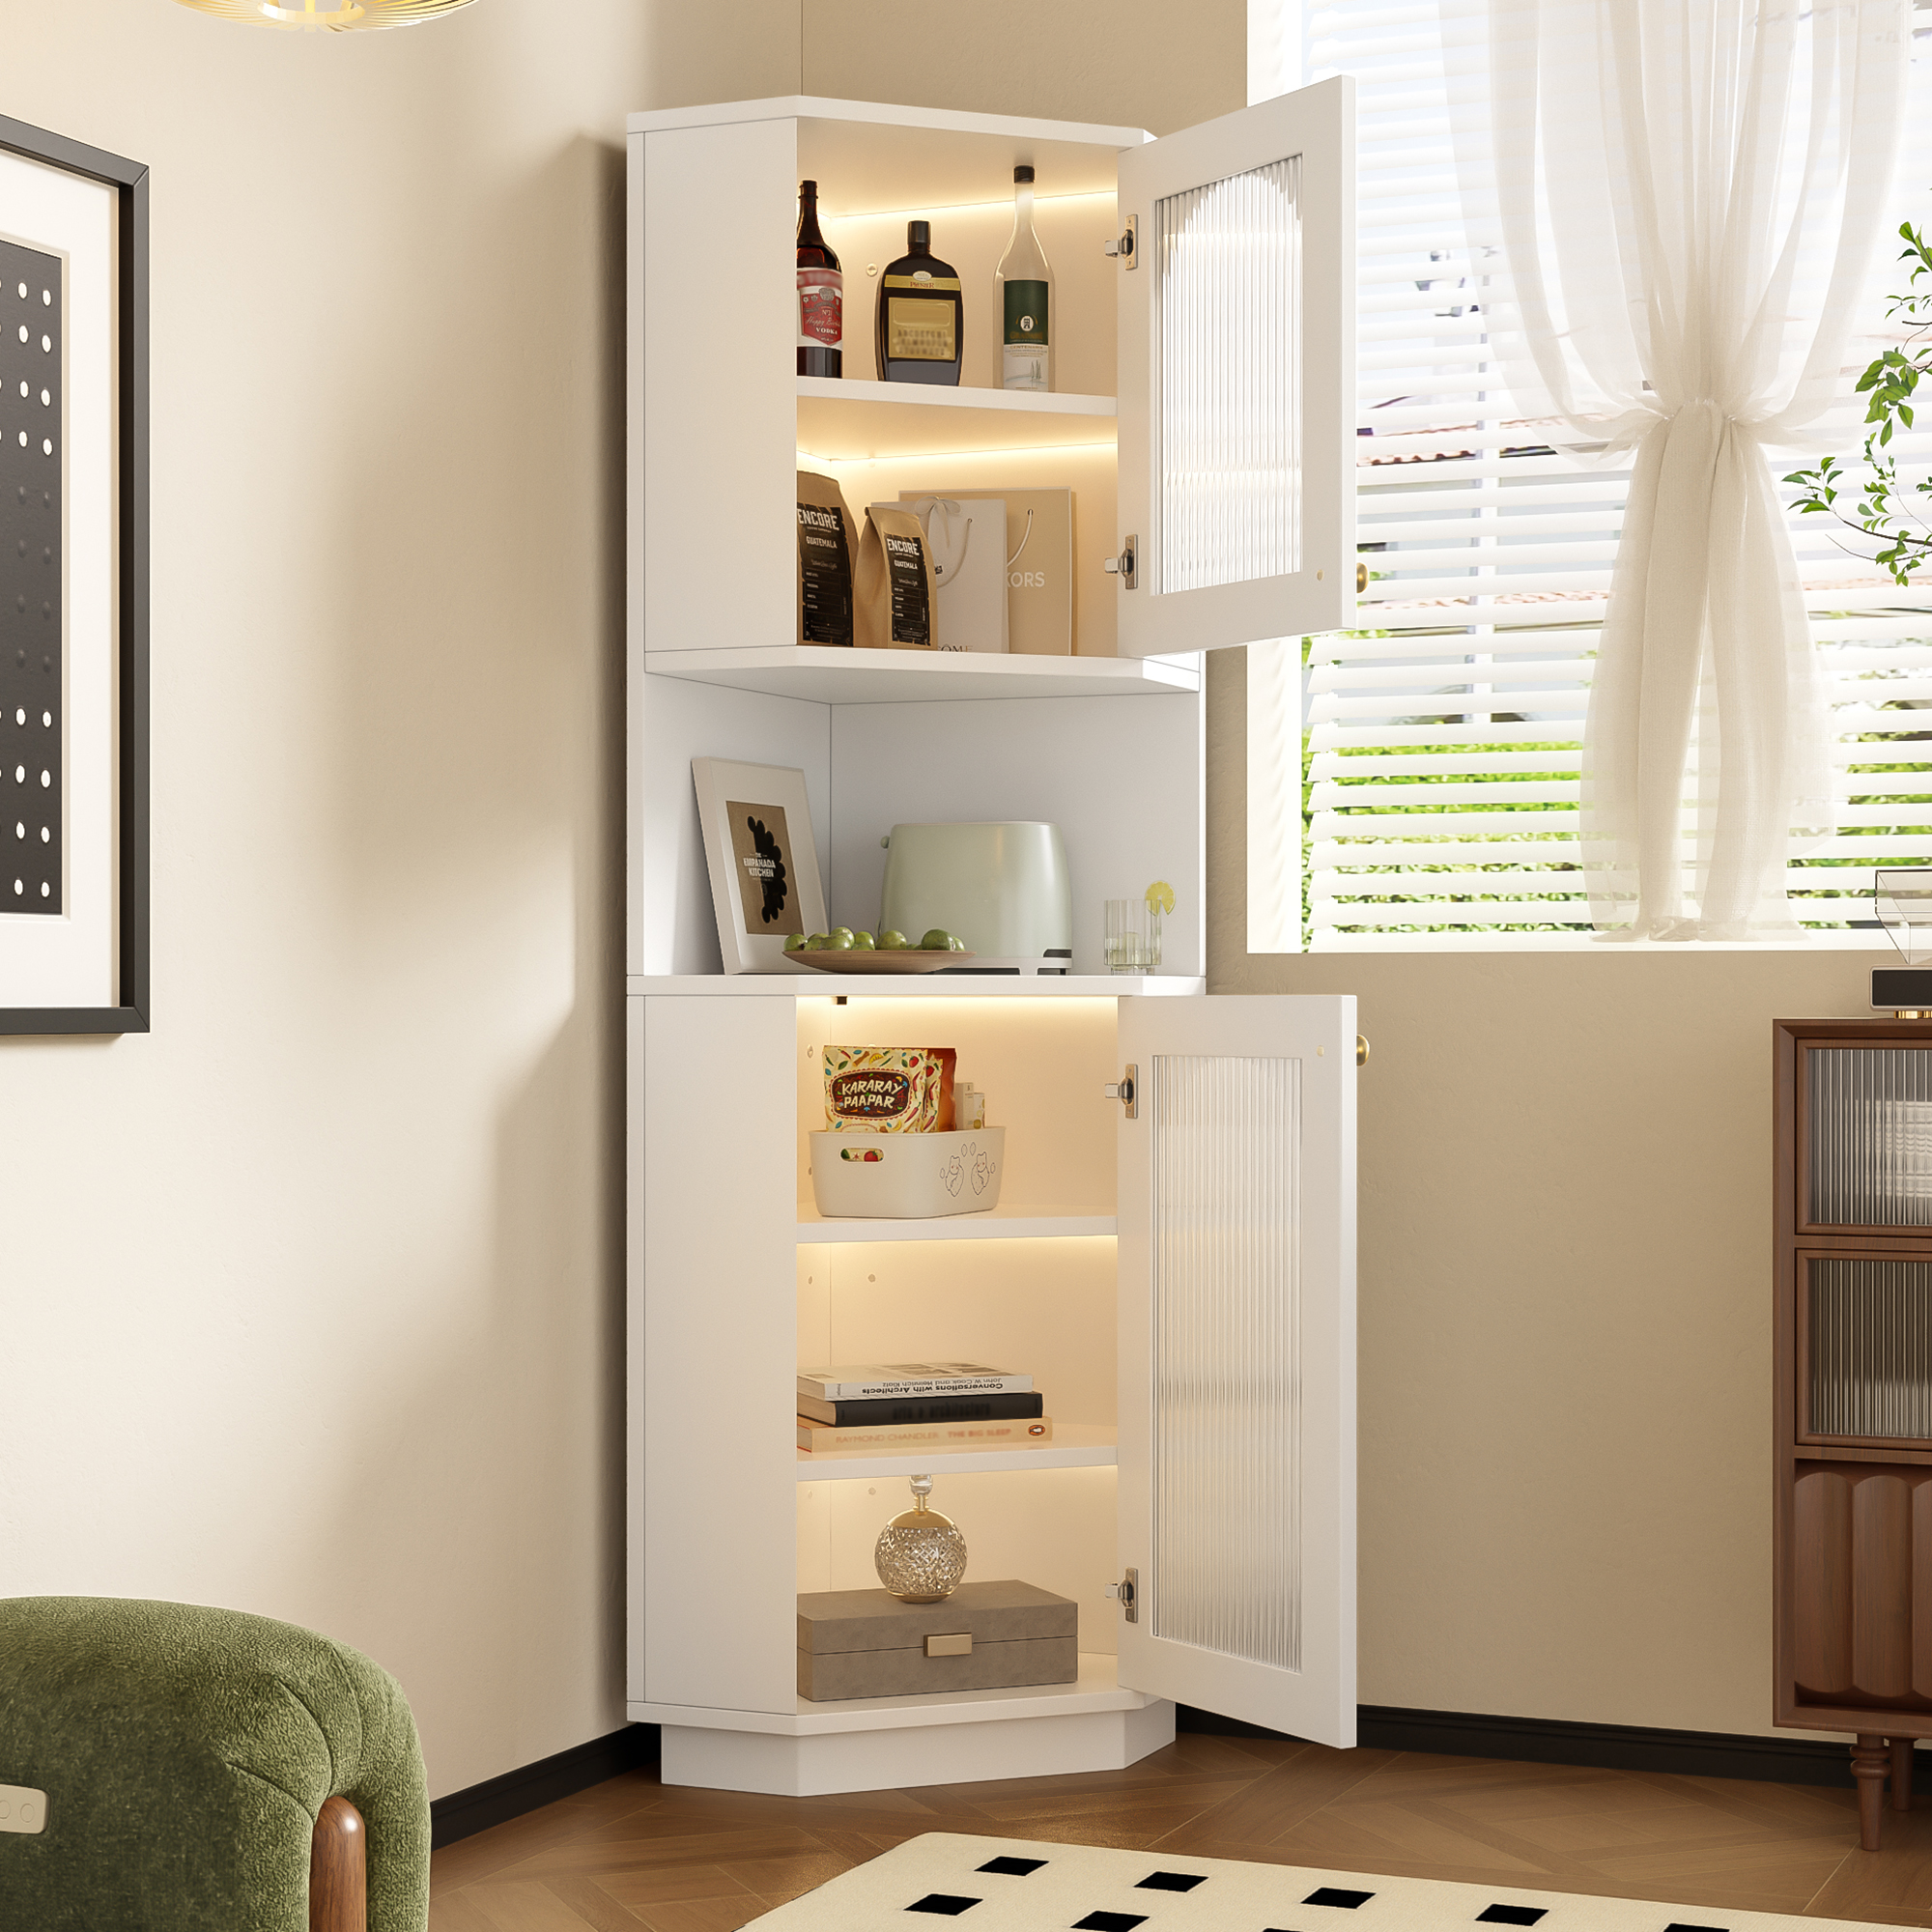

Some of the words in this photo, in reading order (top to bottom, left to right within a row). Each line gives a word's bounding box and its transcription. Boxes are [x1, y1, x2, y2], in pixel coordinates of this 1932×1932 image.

[815, 327, 838, 336] VODKA
[797, 508, 839, 531] ENCORE
[806, 536, 838, 549] GUATEMALA
[886, 538, 920, 555] ENCORE
[894, 559, 919, 570] GUATEMALA
[743, 857, 777, 869] EMPANADA
[748, 867, 775, 878] KITCHEN
[841, 1079, 904, 1095] KARARAY
[843, 1094, 895, 1109] PAAPAR
[836, 1434, 885, 1444] RAYMOND
[888, 1432, 940, 1441] CHANDLER
[948, 1430, 965, 1438] THE
[968, 1429, 984, 1437] BIG
[986, 1428, 1011, 1436] SLEEP
